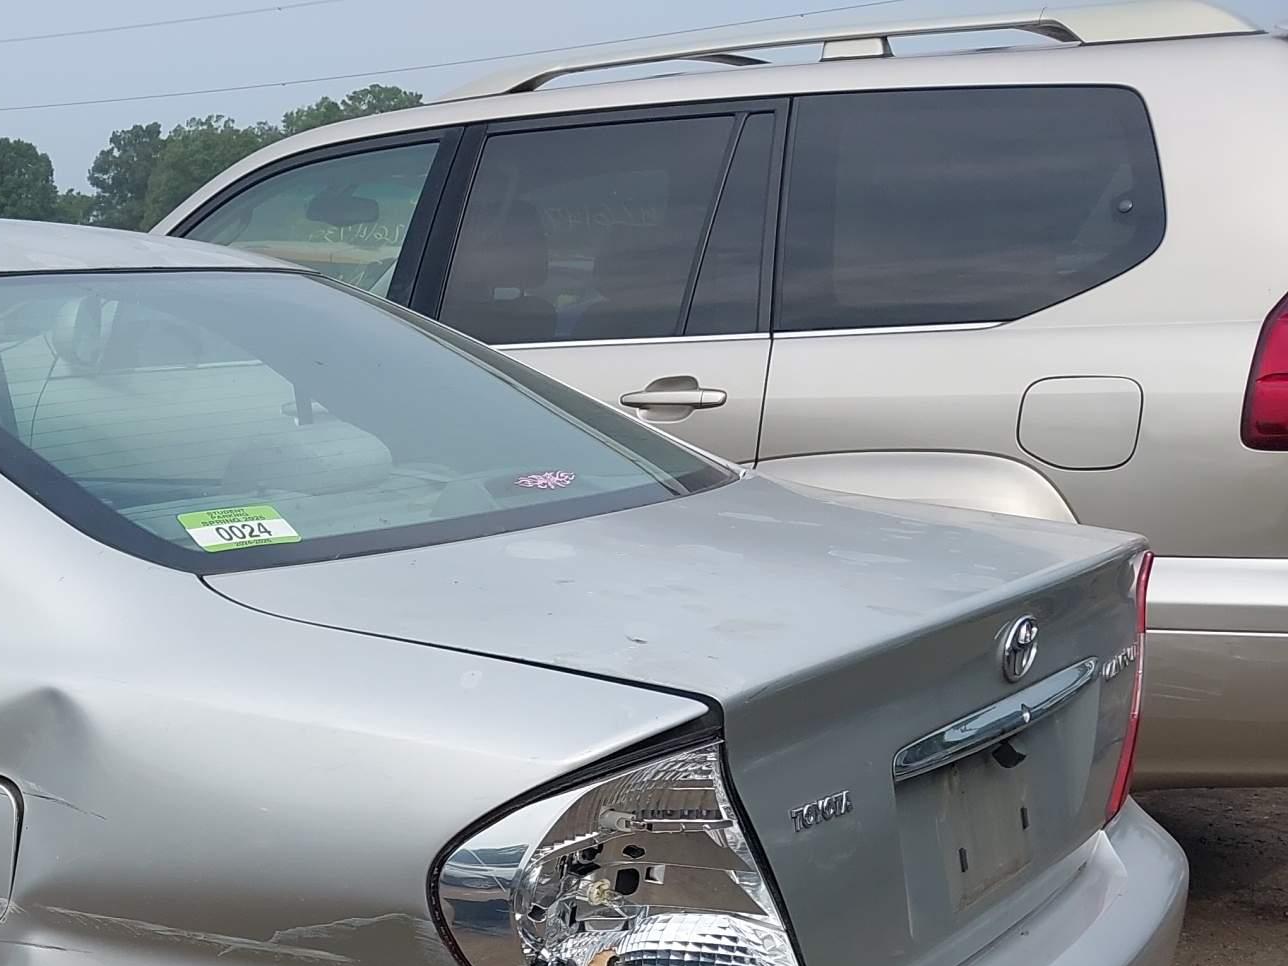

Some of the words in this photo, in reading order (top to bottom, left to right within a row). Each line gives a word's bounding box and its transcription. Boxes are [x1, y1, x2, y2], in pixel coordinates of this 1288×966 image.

[201, 517, 241, 527] SPRING
[215, 522, 273, 542] 0024
[790, 789, 852, 832] TOYOTA
